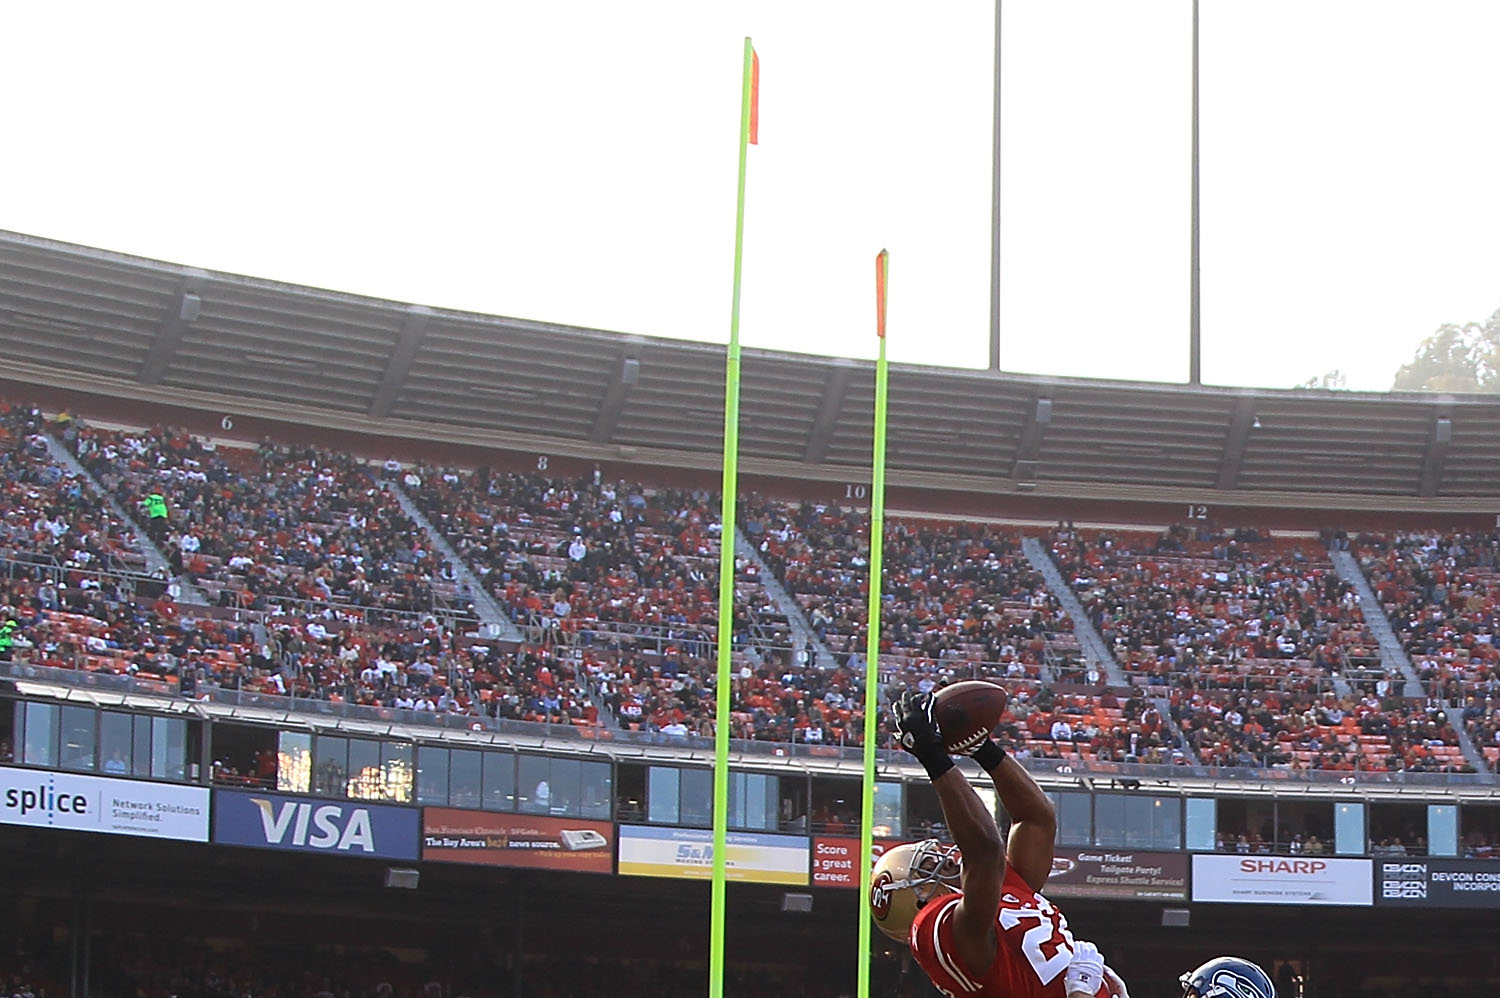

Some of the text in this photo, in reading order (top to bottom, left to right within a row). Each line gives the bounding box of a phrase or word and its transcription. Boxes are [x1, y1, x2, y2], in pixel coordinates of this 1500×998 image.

[221, 416, 232, 430] 6
[537, 456, 548, 470] 8
[846, 485, 866, 499] 10
[1187, 505, 1207, 519] 12
[1340, 777, 1356, 785] 12
[6, 784, 87, 816] splice
[112, 799, 200, 815] Network Solutions
[112, 808, 163, 822] Simplified.
[250, 799, 375, 852] VISA
[426, 837, 444, 847] The
[444, 838, 459, 849] Bay
[817, 843, 848, 856] Score
[813, 858, 852, 870] a great
[1077, 853, 1133, 863] Game Ticket!
[1100, 864, 1162, 875] Tailgate Party!
[1240, 859, 1327, 874] SHARP
[813, 871, 851, 882] career.
[1086, 875, 1184, 886] Express Shuttle Service!
[1431, 872, 1473, 882] DEVCON
